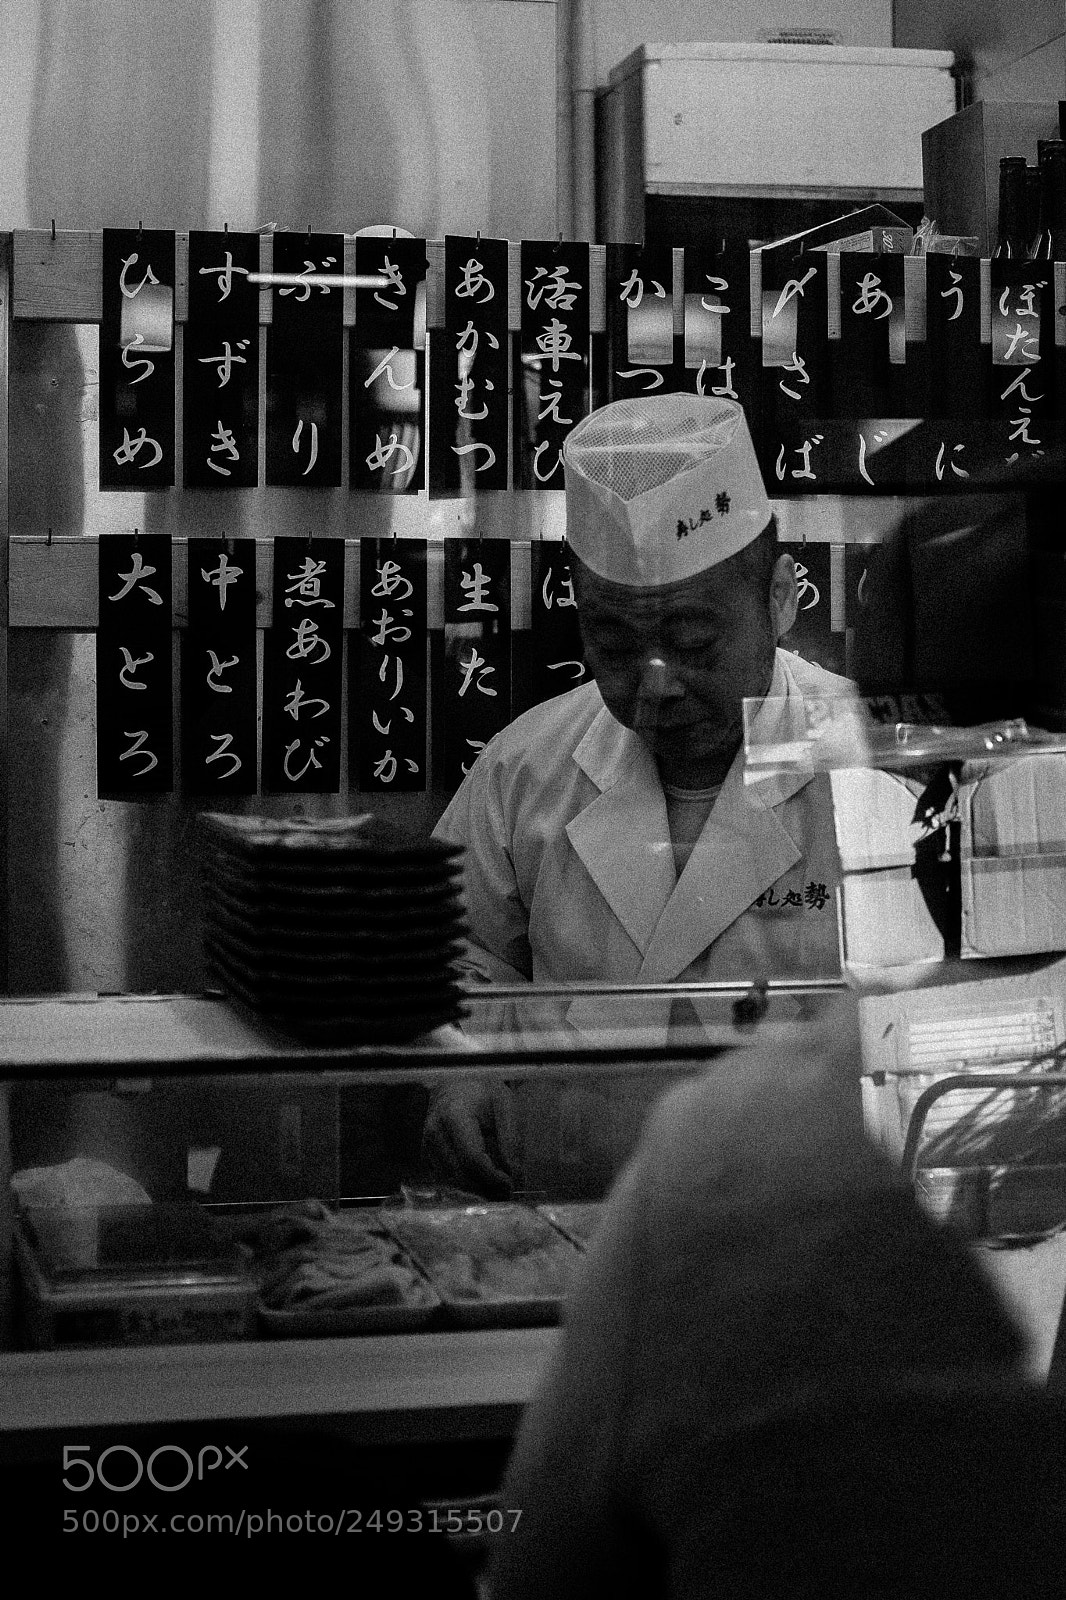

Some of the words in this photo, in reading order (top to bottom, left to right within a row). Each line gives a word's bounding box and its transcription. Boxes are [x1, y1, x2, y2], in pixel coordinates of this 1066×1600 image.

[112, 253, 163, 469] ひらめ
[198, 251, 251, 476] すずき
[278, 256, 337, 476] ぶり
[364, 255, 415, 475] きんめ
[451, 258, 500, 472] あかむつ
[852, 272, 893, 486] あじ
[931, 270, 970, 481] うに
[999, 280, 1049, 466] ぼたんえ
[108, 552, 163, 777] 大とろ
[200, 553, 244, 779] 中とろ
[283, 556, 336, 782] 煮あわび
[370, 560, 420, 783] あおりいか
